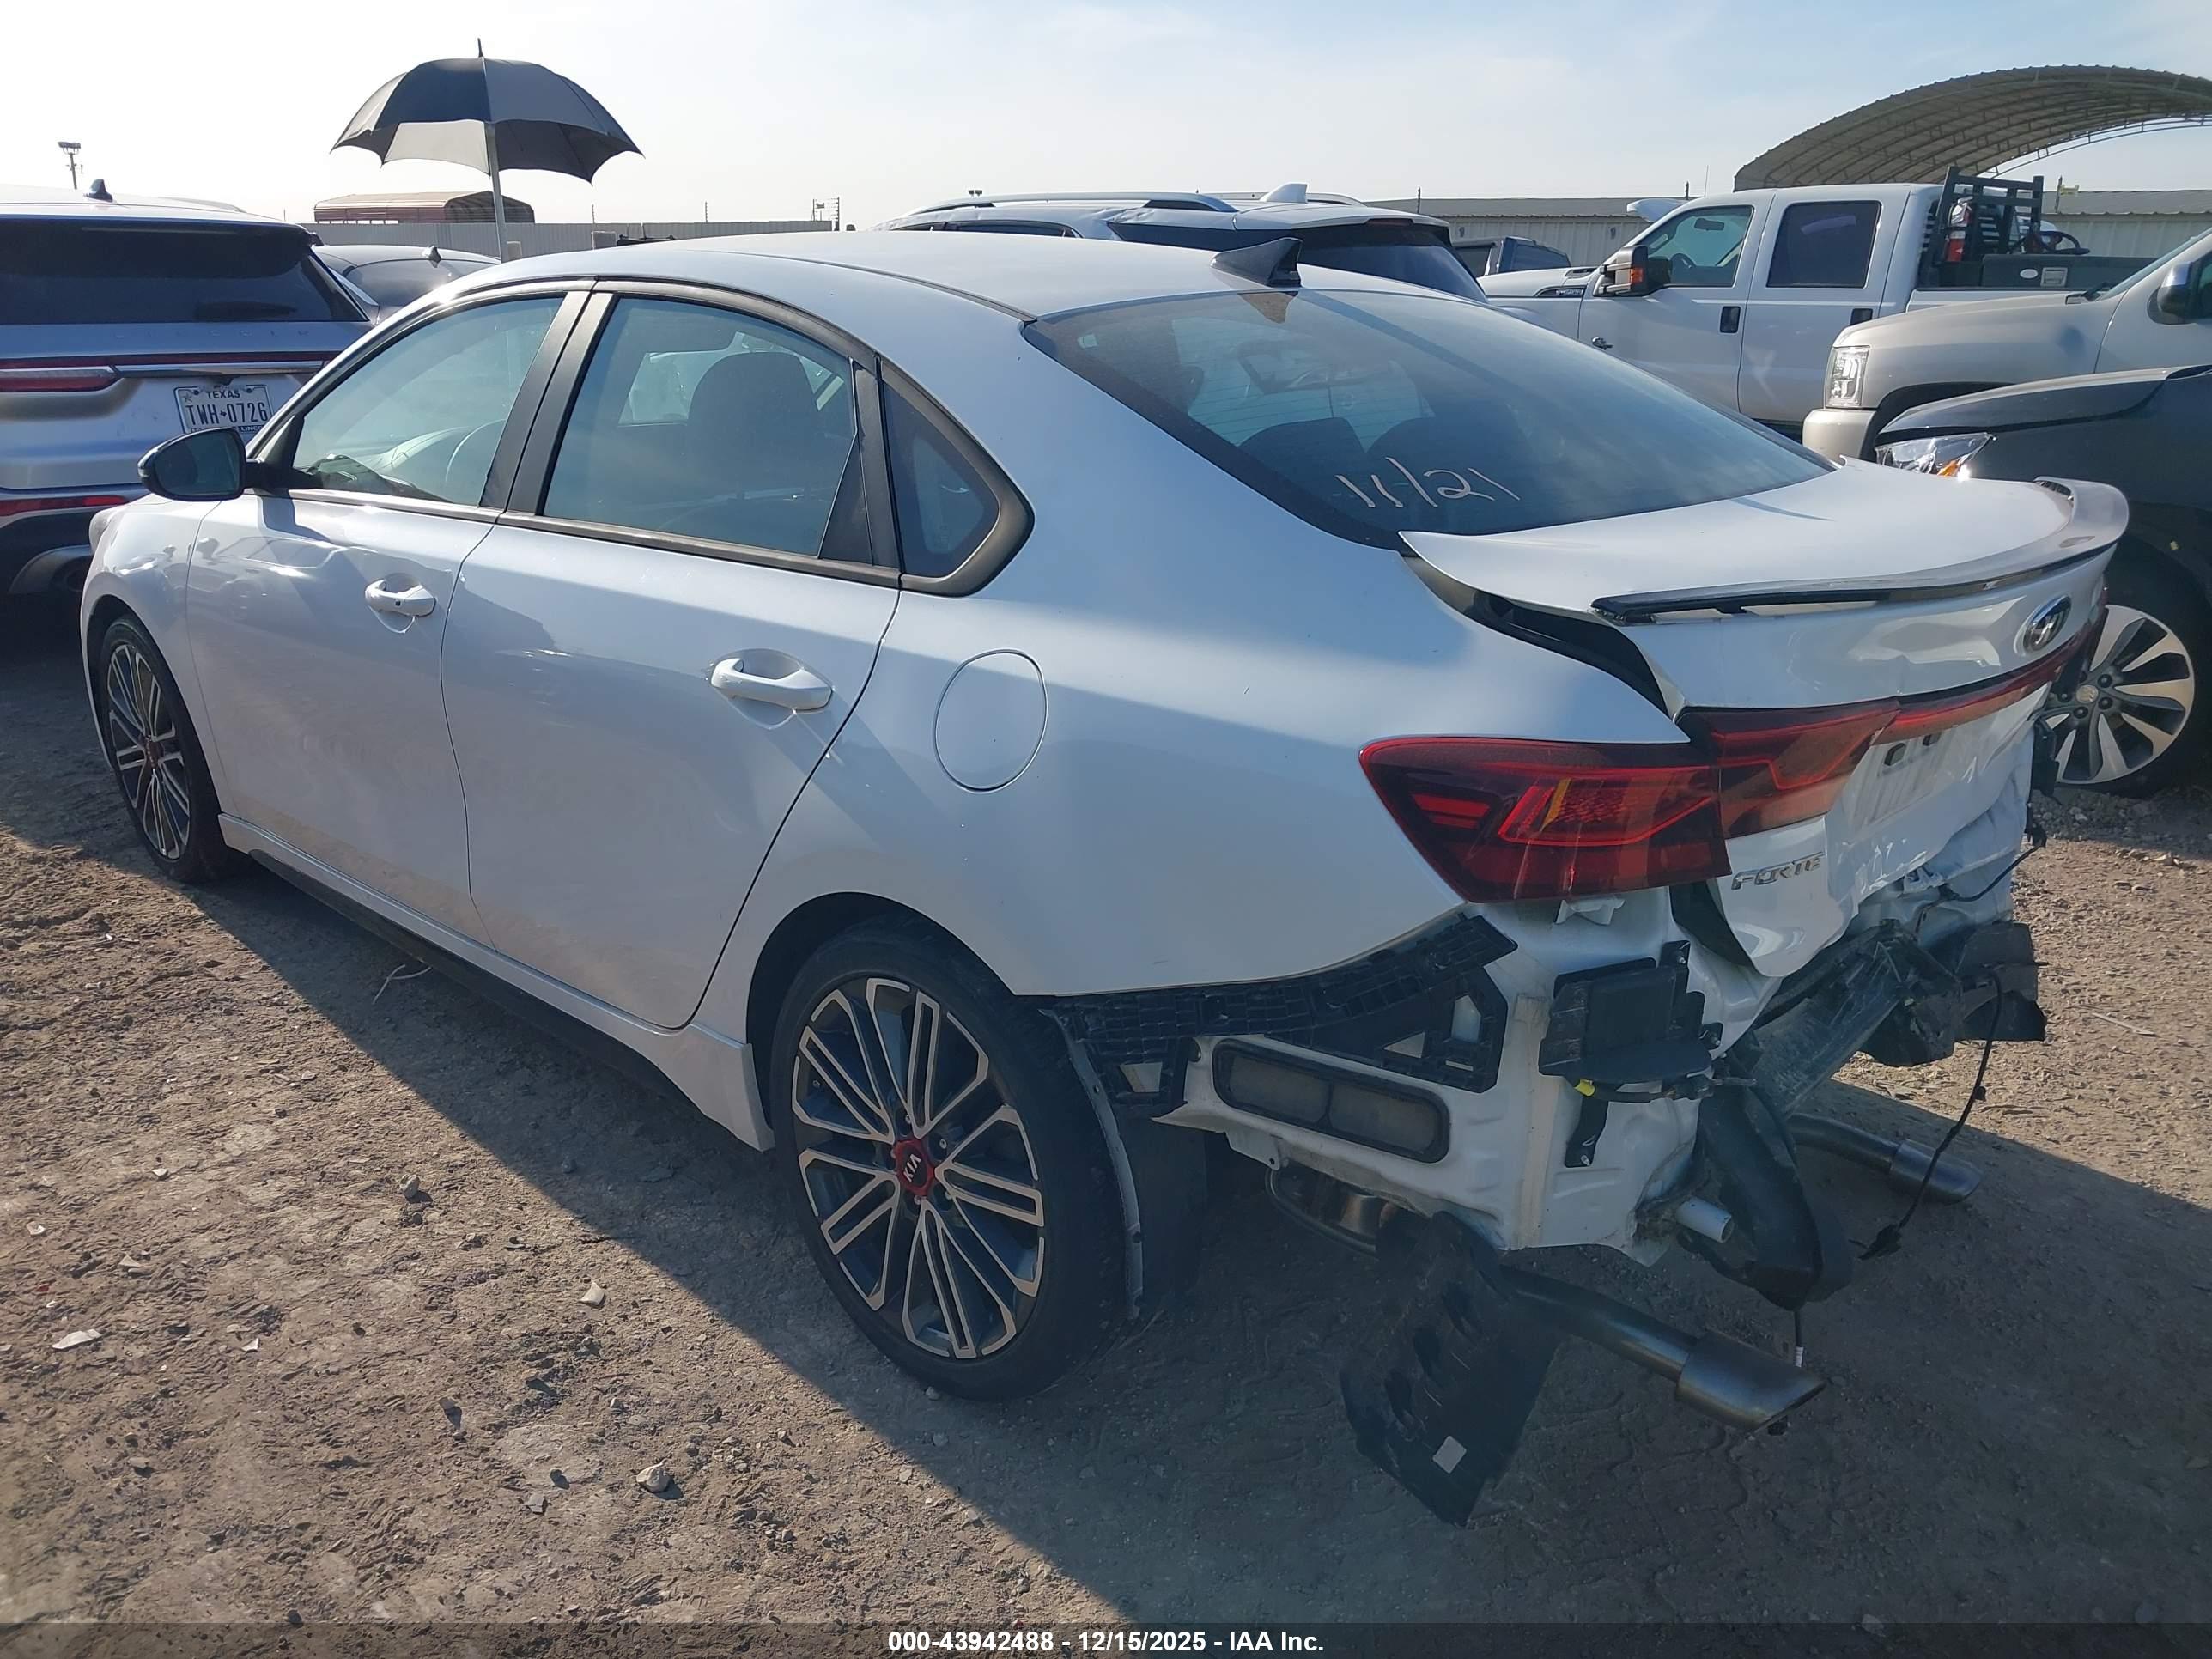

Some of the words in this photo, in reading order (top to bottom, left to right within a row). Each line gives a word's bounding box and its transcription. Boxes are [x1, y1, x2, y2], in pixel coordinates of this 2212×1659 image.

[206, 389, 240, 399] TEXAS
[1334, 456, 1521, 508] 11/21
[1731, 852, 1825, 890] FORTE
[903, 1153, 921, 1182] KIA
